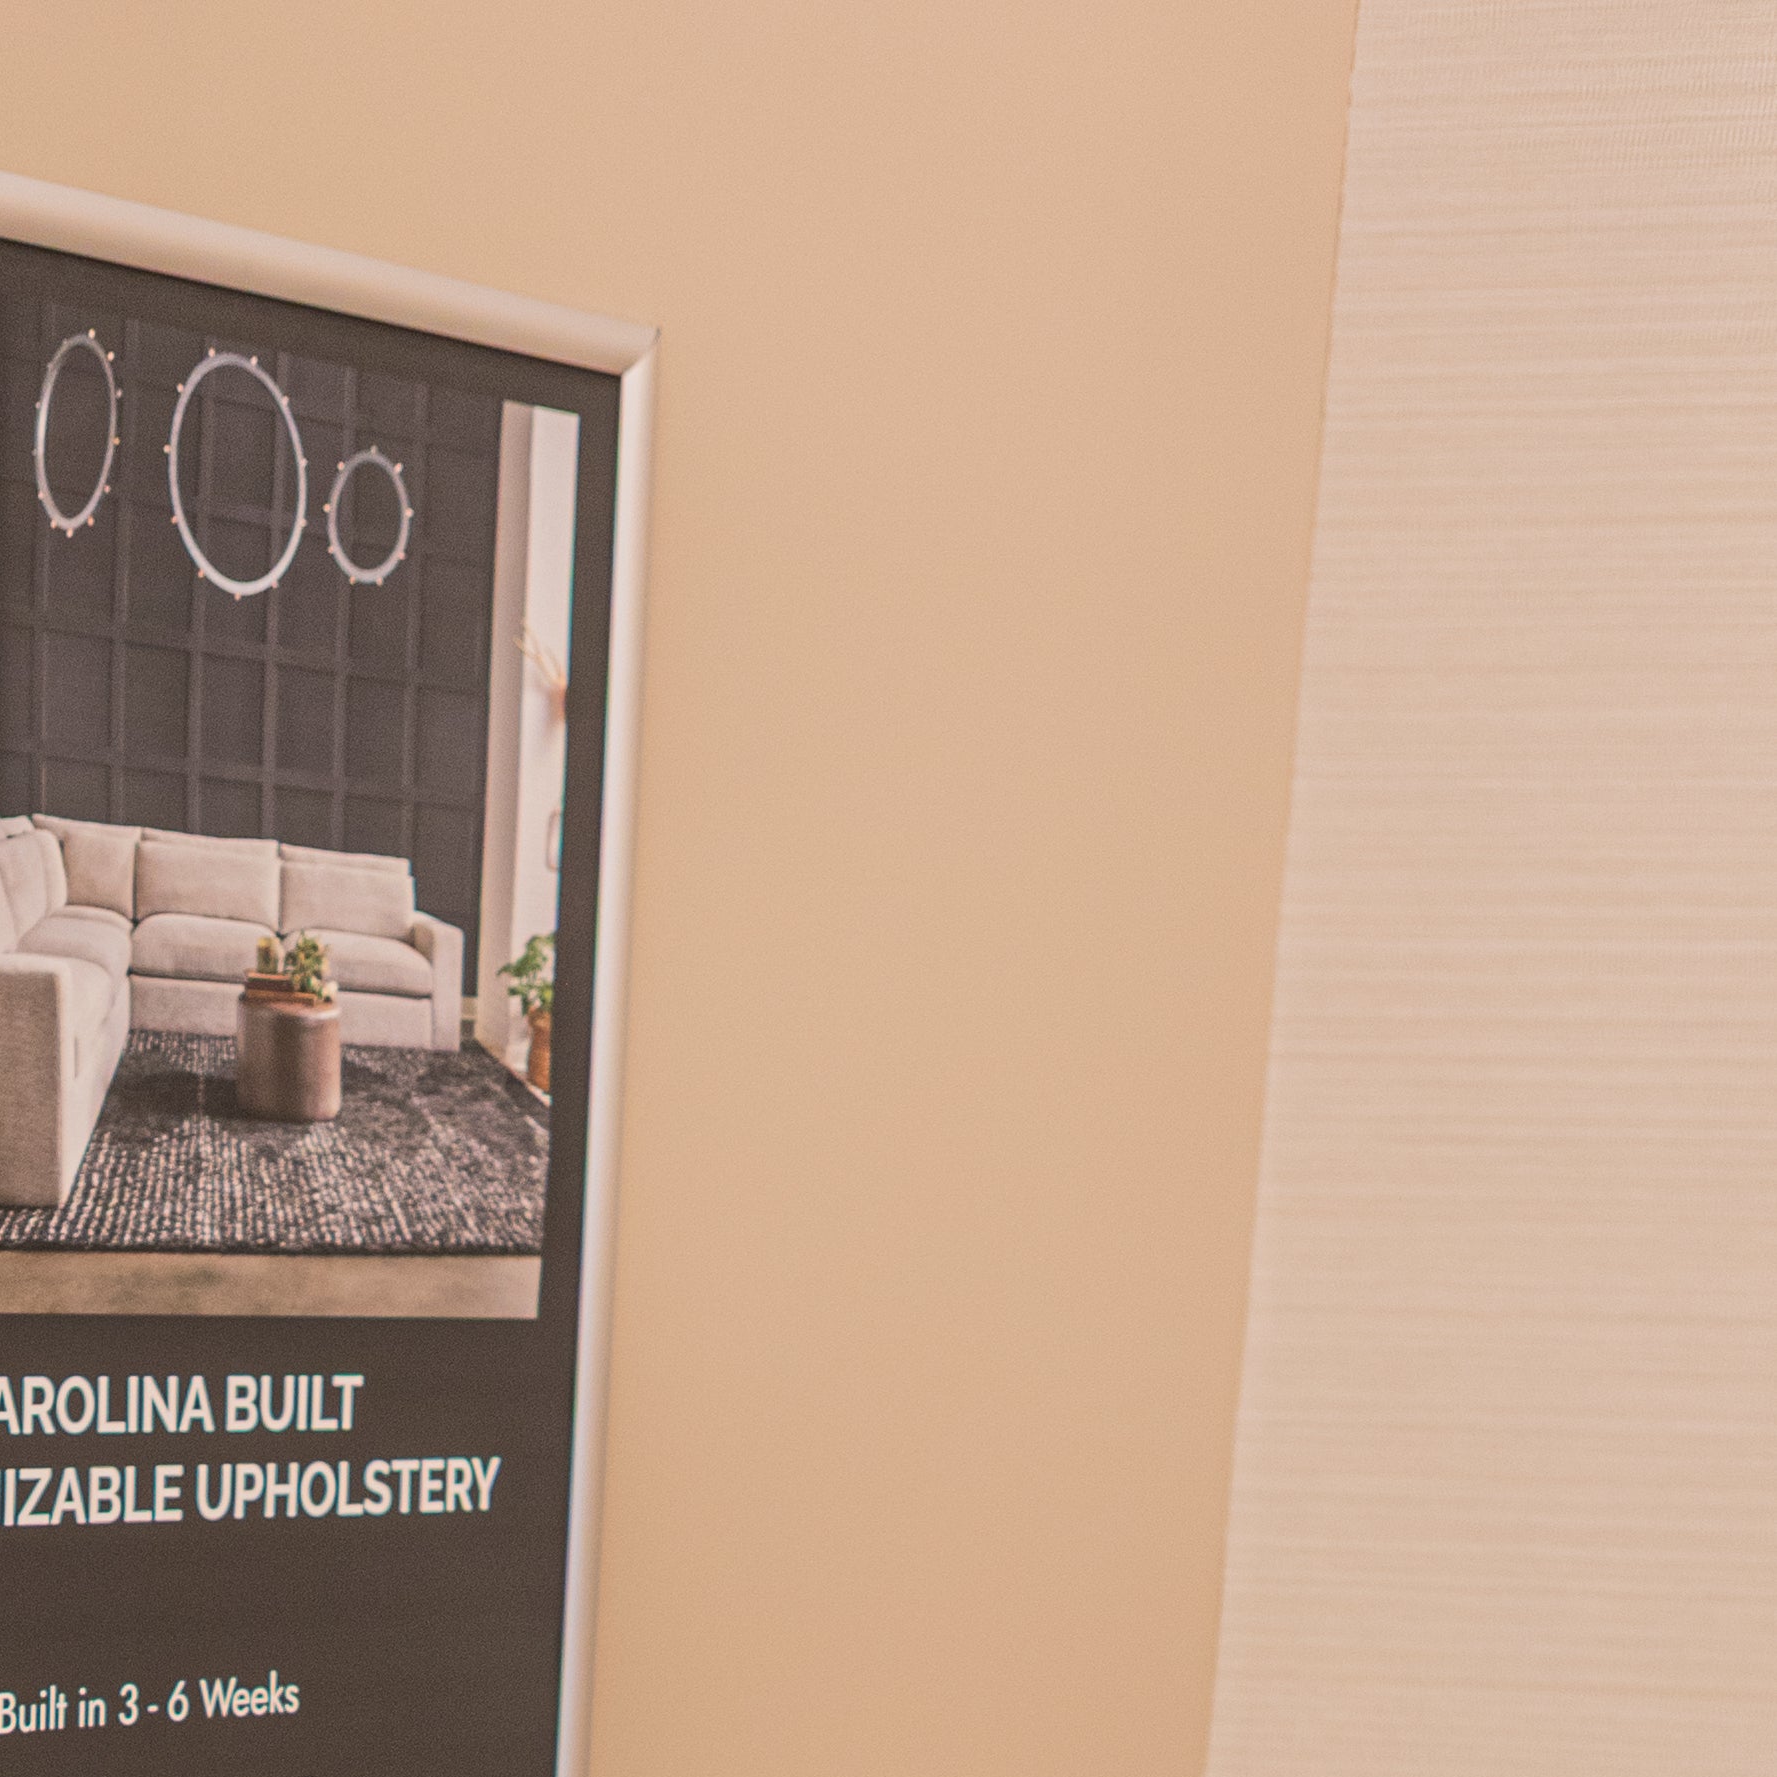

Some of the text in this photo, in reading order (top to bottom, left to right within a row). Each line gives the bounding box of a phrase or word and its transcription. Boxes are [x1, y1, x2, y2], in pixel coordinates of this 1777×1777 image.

[226, 1372, 364, 1433] BUILT
[196, 1456, 501, 1520] UPHOLSTERY
[77, 1686, 106, 1729] in
[118, 1683, 139, 1726] 3
[147, 1702, 159, 1712] -
[167, 1678, 190, 1722] 6
[199, 1670, 300, 1719] Weeks
